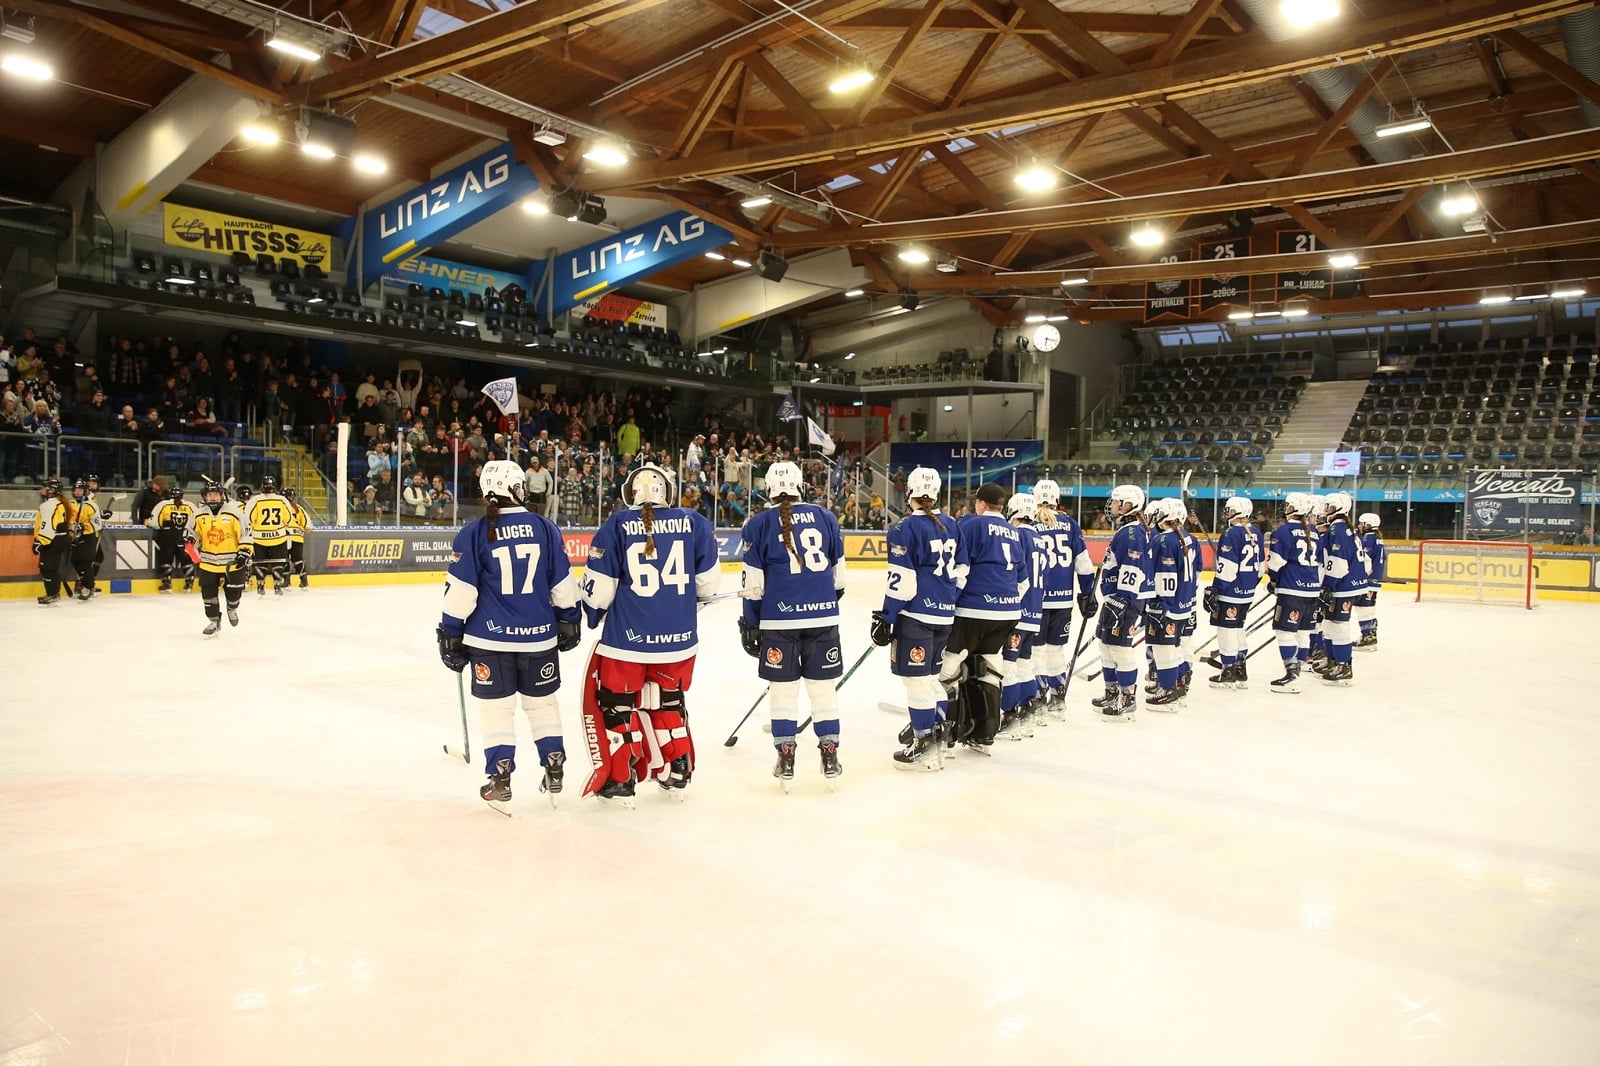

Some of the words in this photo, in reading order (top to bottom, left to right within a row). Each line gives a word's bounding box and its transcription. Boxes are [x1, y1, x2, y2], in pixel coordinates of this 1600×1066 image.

[380, 181, 450, 239] LINZ
[457, 153, 509, 203] AG
[171, 216, 204, 233] Life
[224, 220, 274, 230] HAUPTSACHE
[204, 228, 300, 253] HITSSS
[572, 233, 645, 279] LINZ
[652, 215, 705, 252] AG
[1295, 234, 1316, 252] 21
[1214, 244, 1235, 259] 25
[397, 259, 497, 287] EHNER
[1151, 297, 1185, 308] PERTHALER
[991, 448, 1016, 458] AG
[1468, 470, 1575, 499] Icecats
[261, 508, 281, 526] 23
[495, 524, 534, 540] LUGER
[331, 540, 401, 558] BLÅKLÄDER
[412, 541, 432, 551] WEIL
[778, 528, 829, 575] 18
[1001, 542, 1014, 571] 1
[491, 543, 541, 595] 17
[626, 540, 690, 597] 64
[1327, 560, 1333, 571] 8
[1121, 571, 1137, 586] 26
[1163, 578, 1176, 591] 10
[796, 601, 836, 612] LIWEST
[506, 623, 552, 635] LIWEST
[646, 630, 693, 644] LIWEST
[584, 714, 604, 770] VAUGHN
